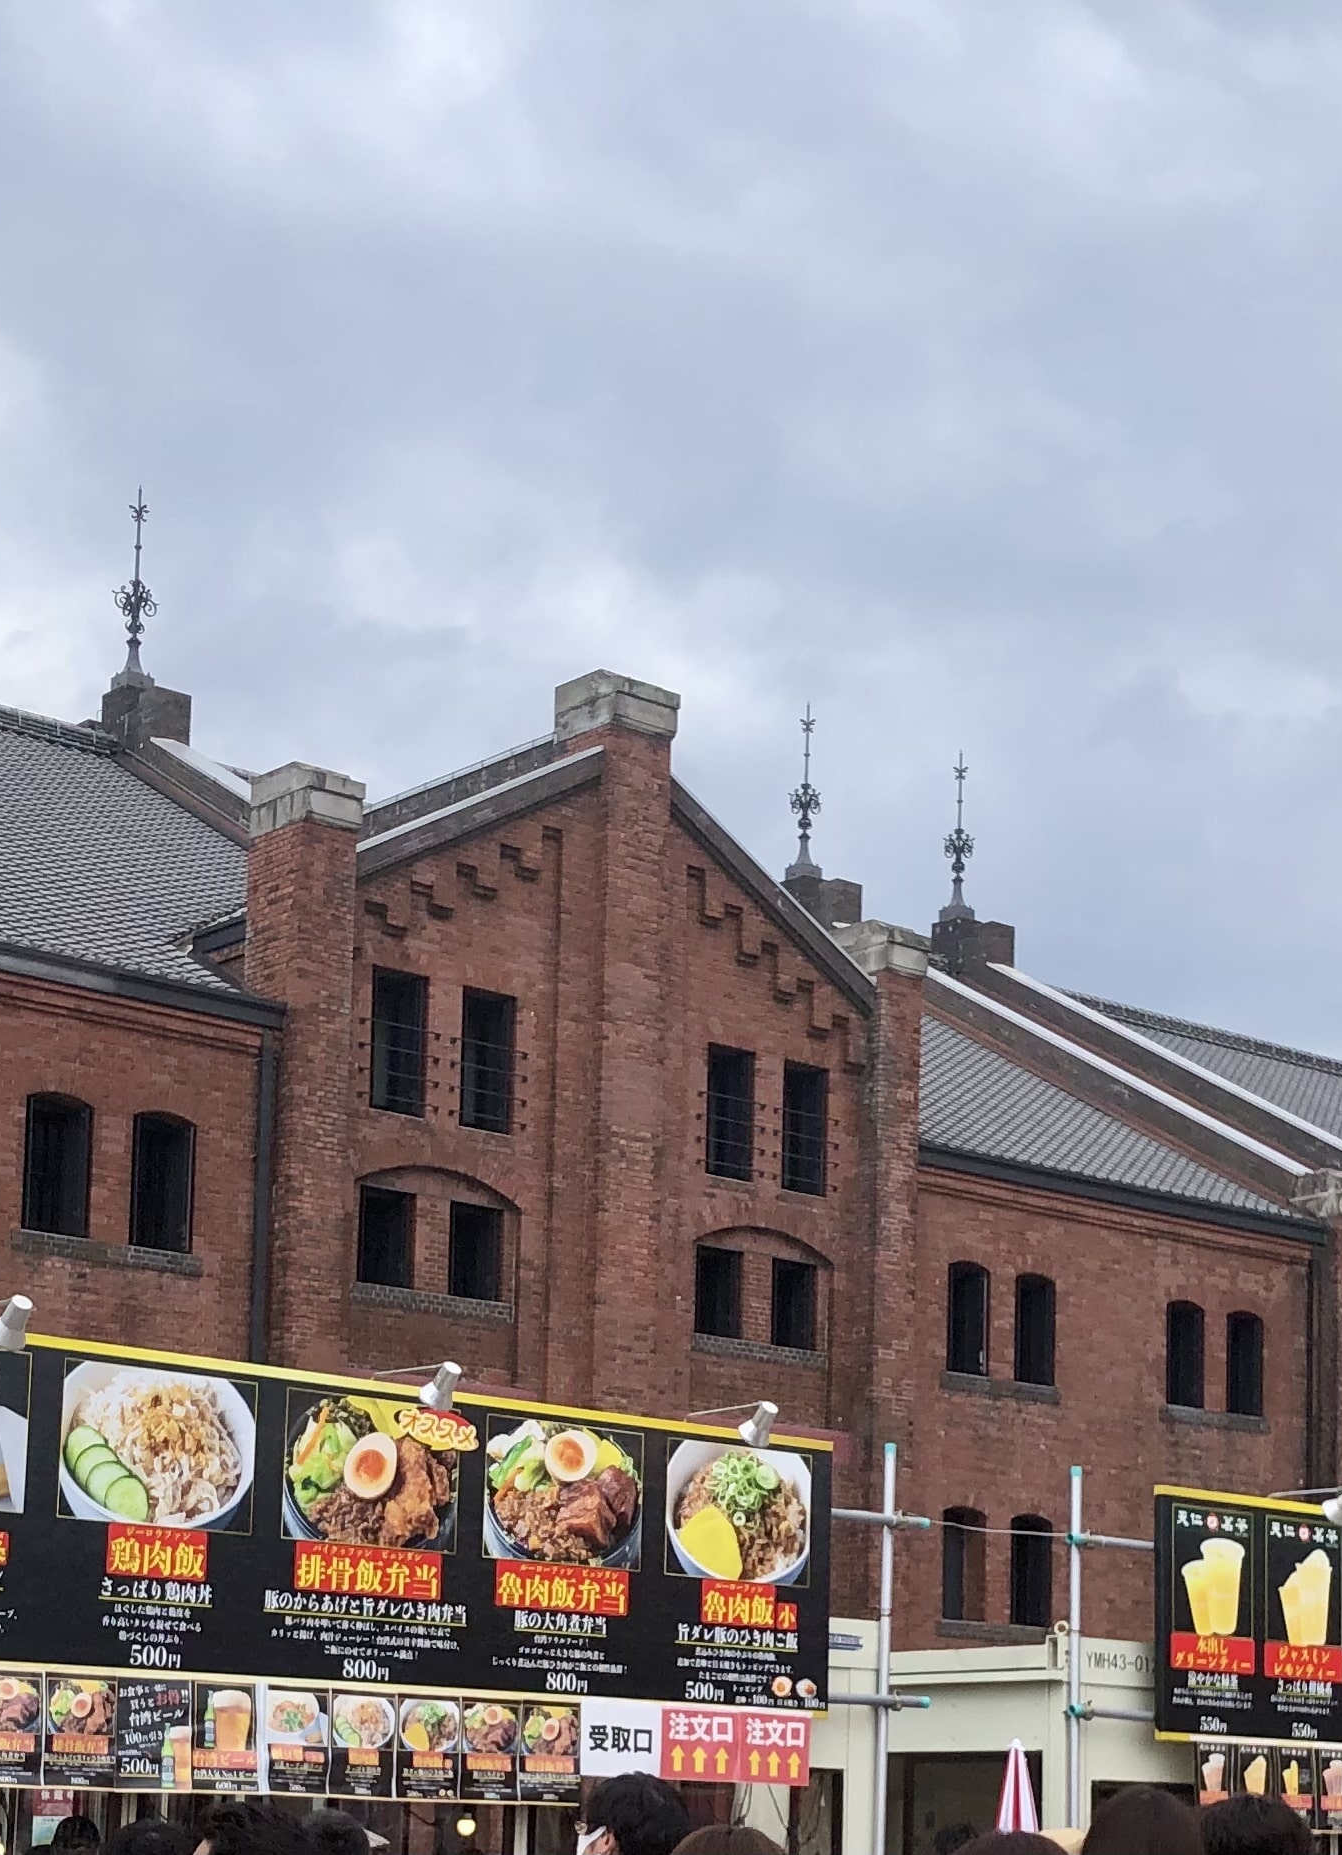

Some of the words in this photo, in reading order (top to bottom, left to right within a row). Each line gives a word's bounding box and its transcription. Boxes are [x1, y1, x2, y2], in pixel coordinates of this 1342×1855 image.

[399, 1409, 478, 1450] オススメ
[110, 1536, 205, 1578] 鶏肉飯
[297, 1554, 438, 1599] 排骨飯弁当
[101, 1576, 213, 1604] さっぱり鶏肉丼
[498, 1571, 625, 1614] 魯肉飯弁当
[264, 1590, 467, 1623] 豚のからあげと旨ダレひき肉弁当
[705, 1590, 775, 1625] 魯肉飯
[778, 1605, 796, 1628] 小
[514, 1610, 607, 1635] 豚の大角煮弁当
[677, 1623, 798, 1649] 旨ダレ豚のひき肉ご飯
[129, 1644, 181, 1669] 500円
[1086, 1651, 1155, 1673] YMH43-01
[1175, 1650, 1252, 1671] グリーンティー
[1279, 1646, 1331, 1664] ジャスミン
[342, 1658, 390, 1681] 800円
[545, 1671, 588, 1693] 800円
[1274, 1662, 1336, 1680] レモンティー
[685, 1681, 724, 1702] 500円
[668, 1712, 734, 1743] 注文口
[746, 1717, 806, 1748] 注文口
[1199, 1715, 1228, 1733] 550円
[1291, 1721, 1318, 1739] 550円
[588, 1724, 653, 1754] 受取口
[120, 1757, 159, 1774] 500円
